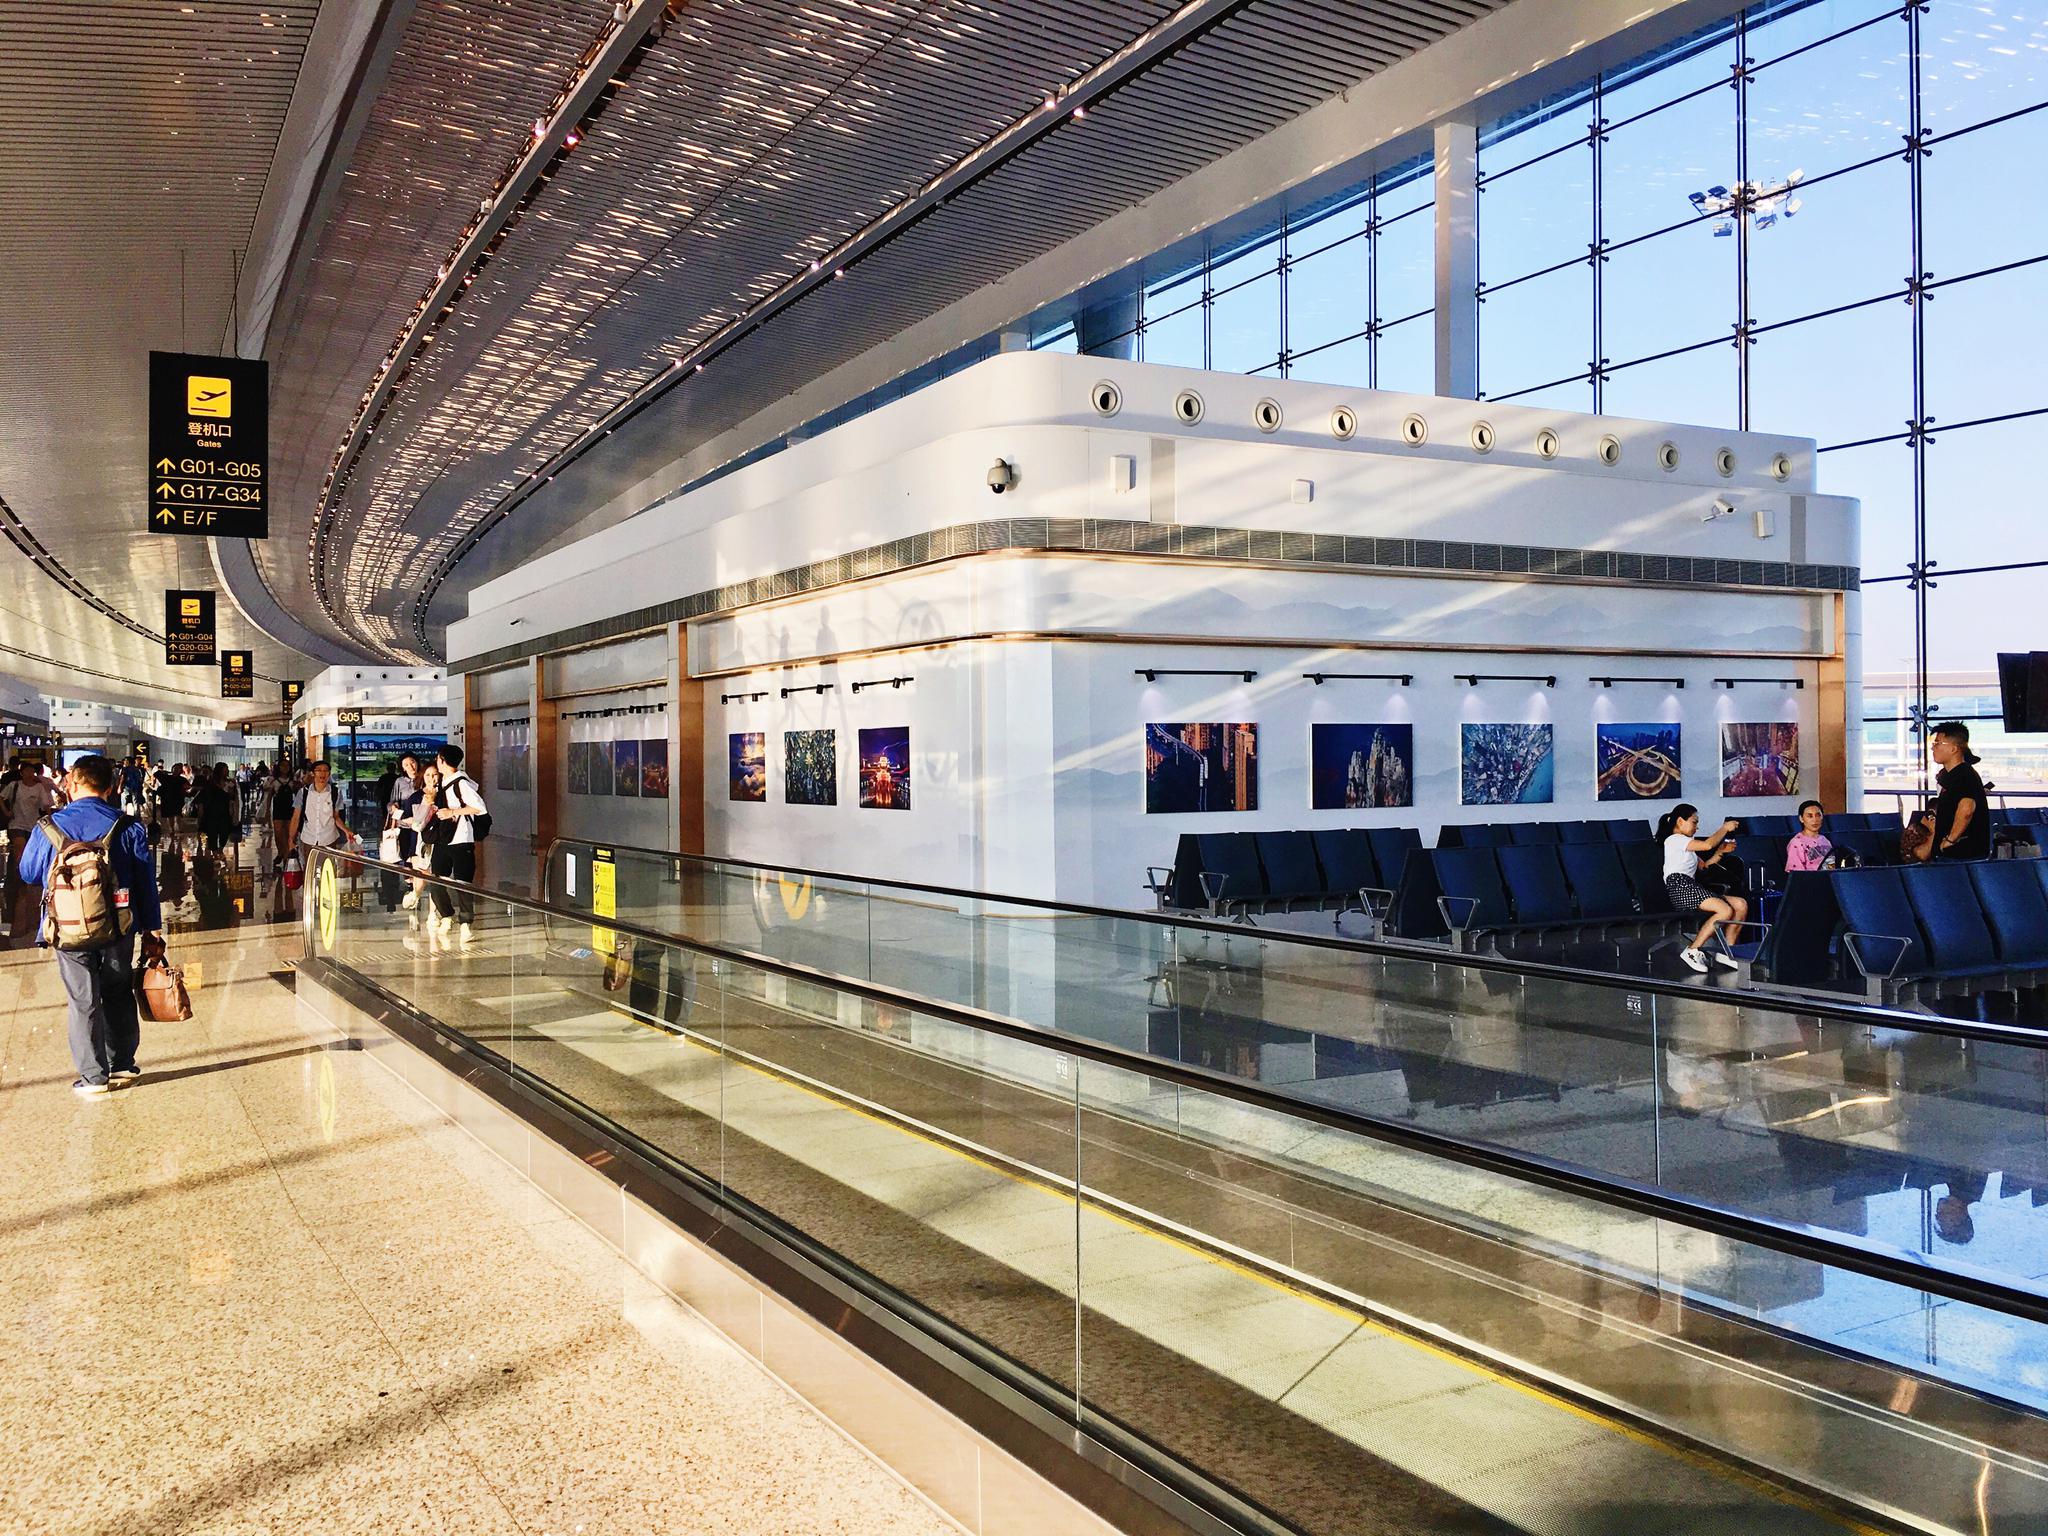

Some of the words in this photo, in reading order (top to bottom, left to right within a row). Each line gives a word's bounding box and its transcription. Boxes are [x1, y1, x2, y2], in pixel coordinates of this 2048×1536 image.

[188, 422, 232, 438] 登机口
[196, 439, 222, 448] Gates
[180, 458, 261, 478] G01-G05
[180, 483, 261, 503] G17-G34
[183, 510, 217, 526] E/F
[178, 632, 213, 641] G01-G04
[178, 643, 213, 651] G20-G34
[338, 712, 360, 722] G05
